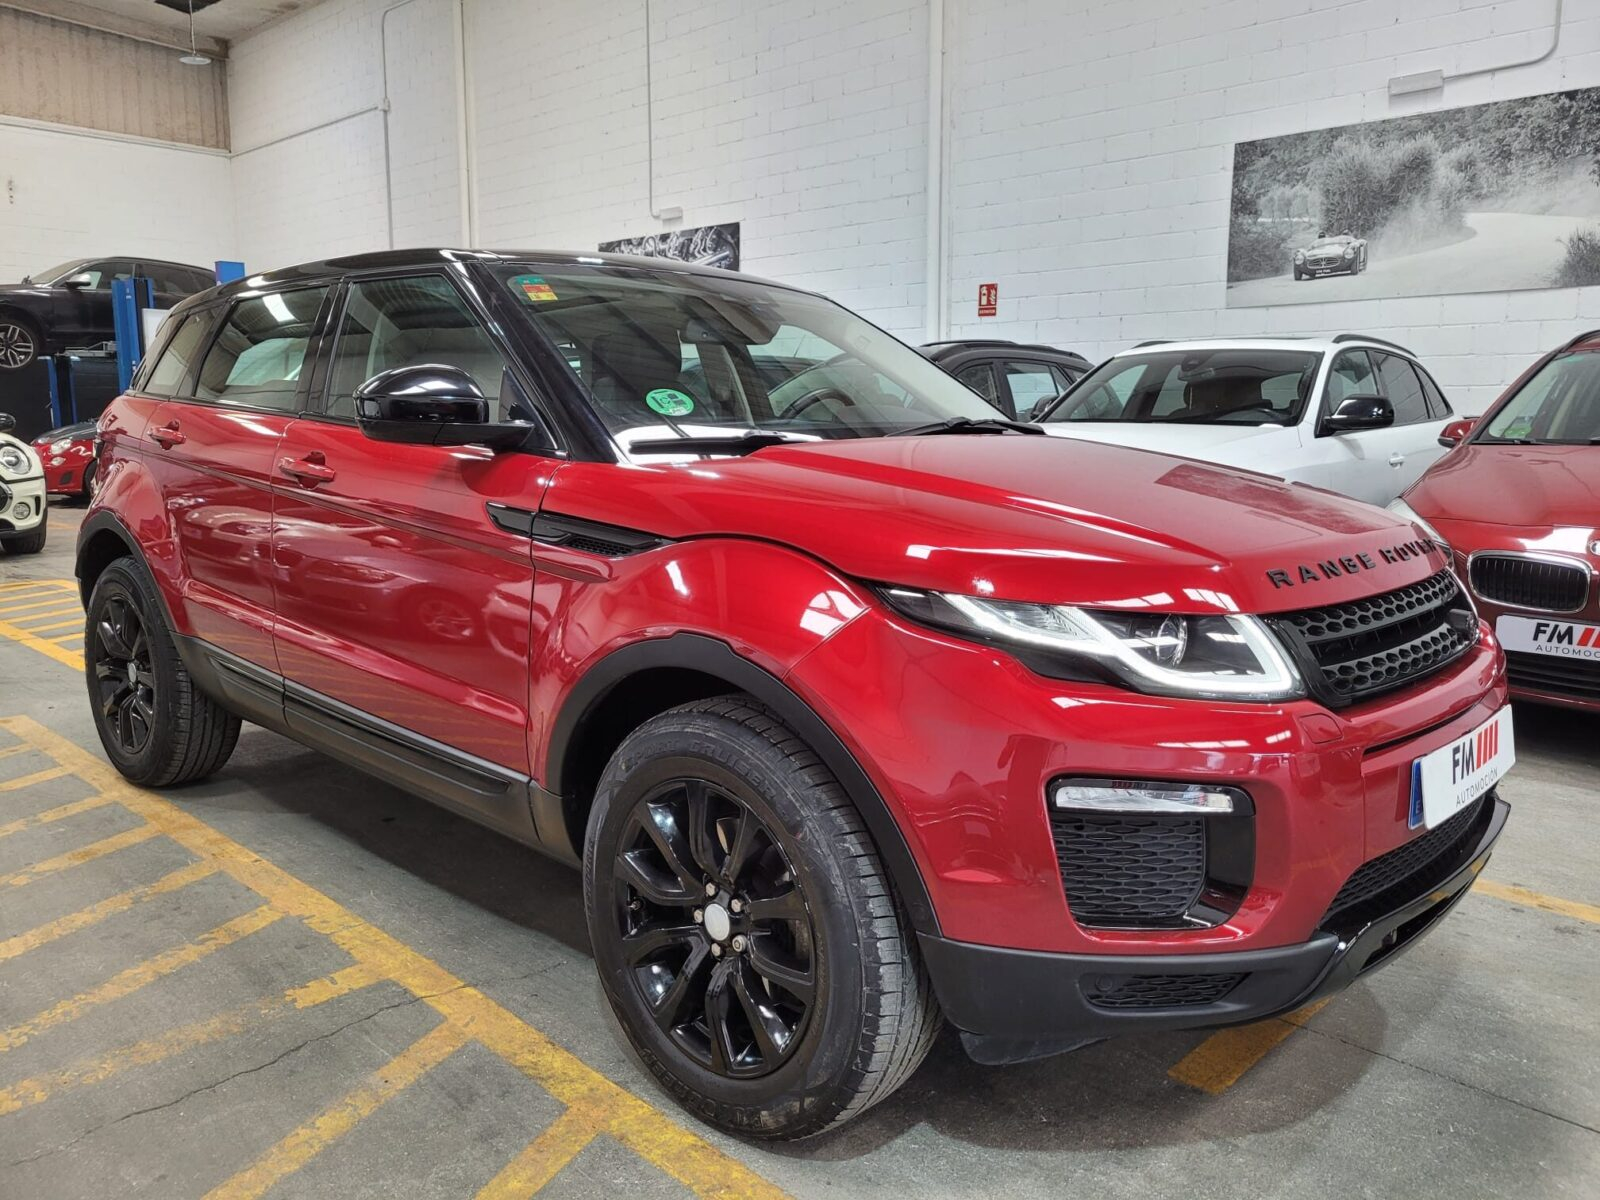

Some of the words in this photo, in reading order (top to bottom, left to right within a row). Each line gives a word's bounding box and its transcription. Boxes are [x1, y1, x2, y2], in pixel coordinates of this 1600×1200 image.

[1265, 552, 1376, 589] RANGE
[1379, 539, 1437, 564] ROVER
[1532, 622, 1574, 646] FM
[1452, 737, 1475, 785] FM
